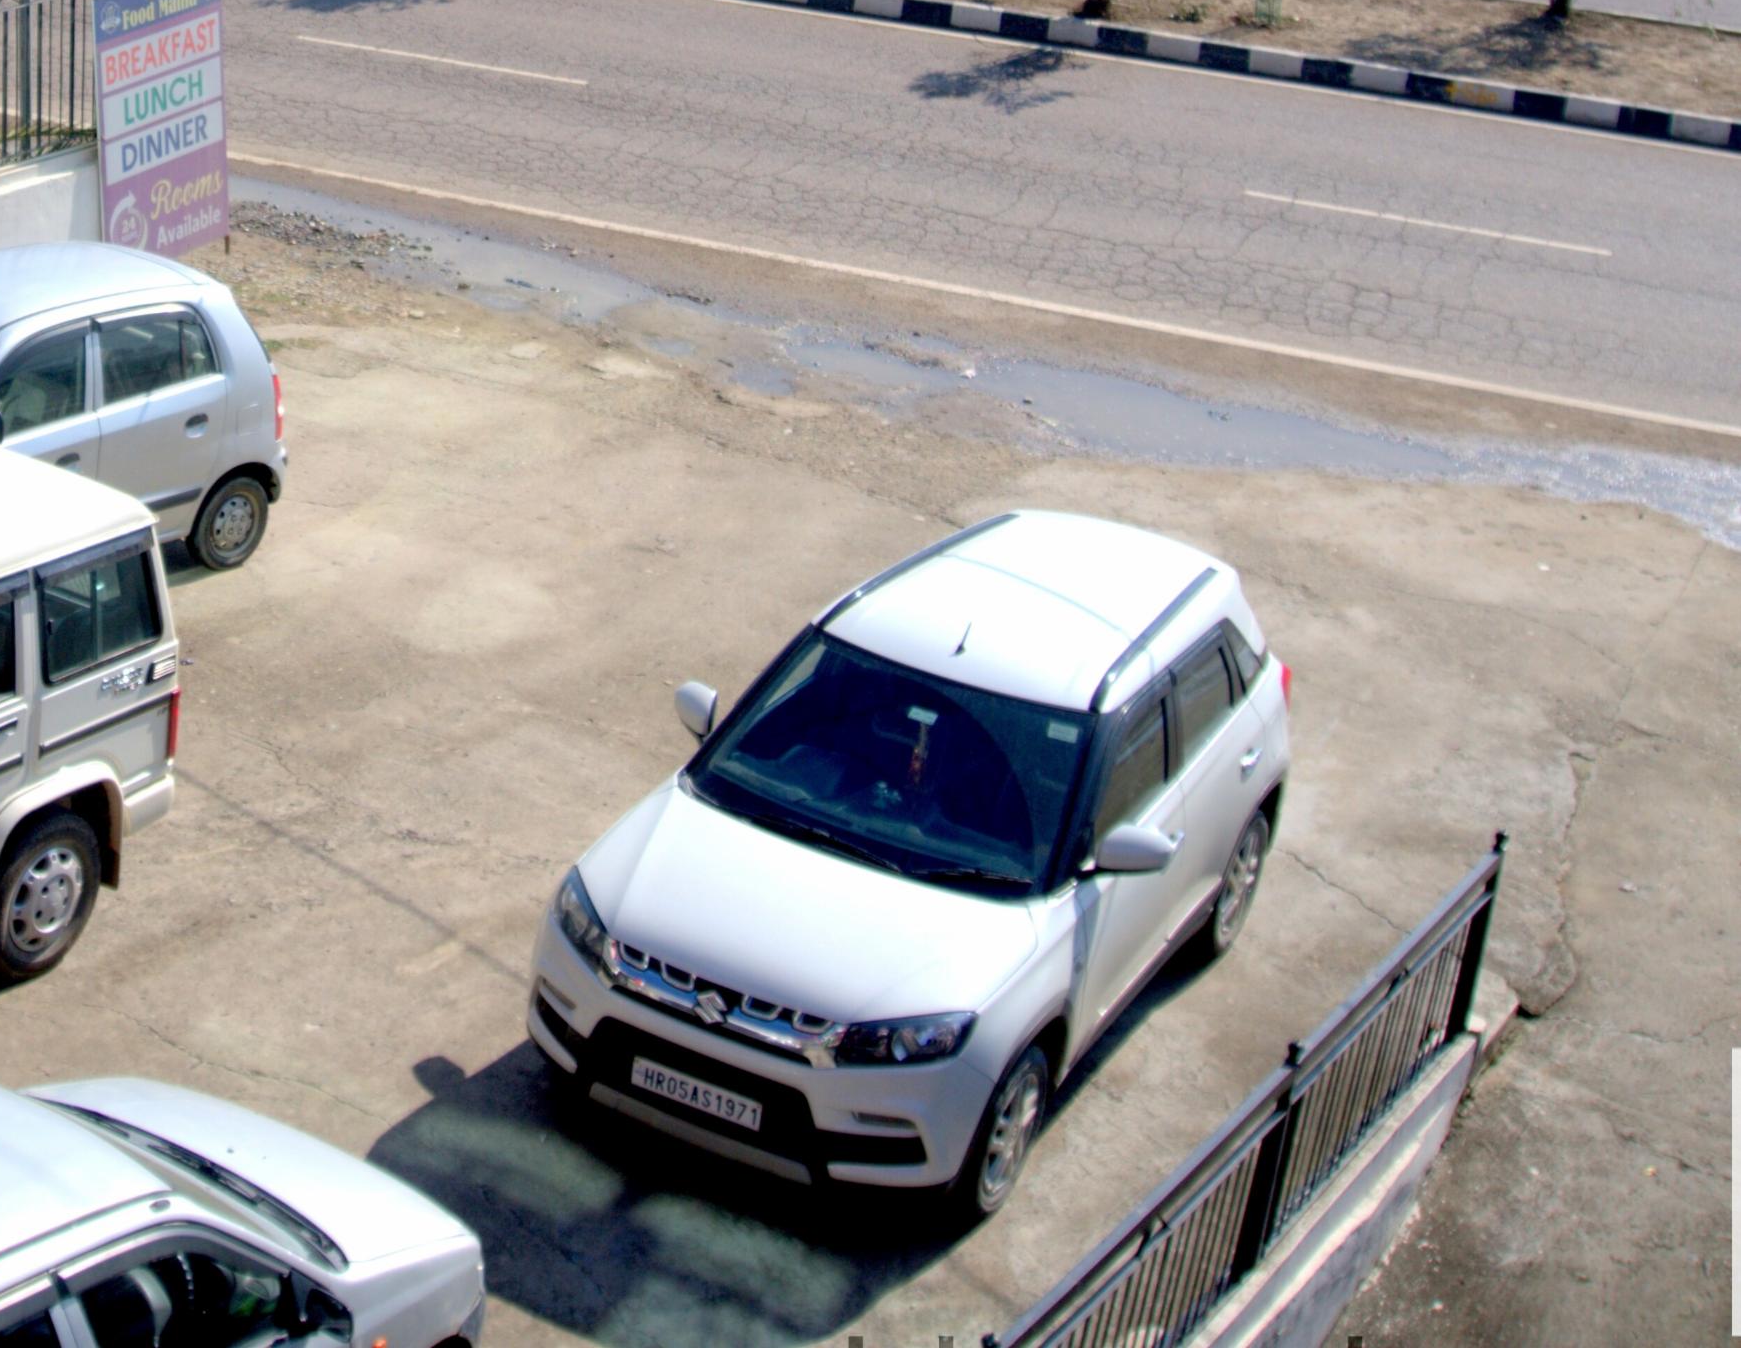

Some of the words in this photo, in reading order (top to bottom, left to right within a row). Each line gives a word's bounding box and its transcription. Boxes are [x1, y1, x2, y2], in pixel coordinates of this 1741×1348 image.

[122, 2, 154, 30] Food
[104, 19, 216, 86] BREAKFAST
[123, 69, 203, 126] LUNCH
[121, 113, 208, 173] DINNER
[150, 170, 223, 220] Rooms
[157, 205, 221, 249] Available
[644, 1068, 758, 1126] HR05AS1971
